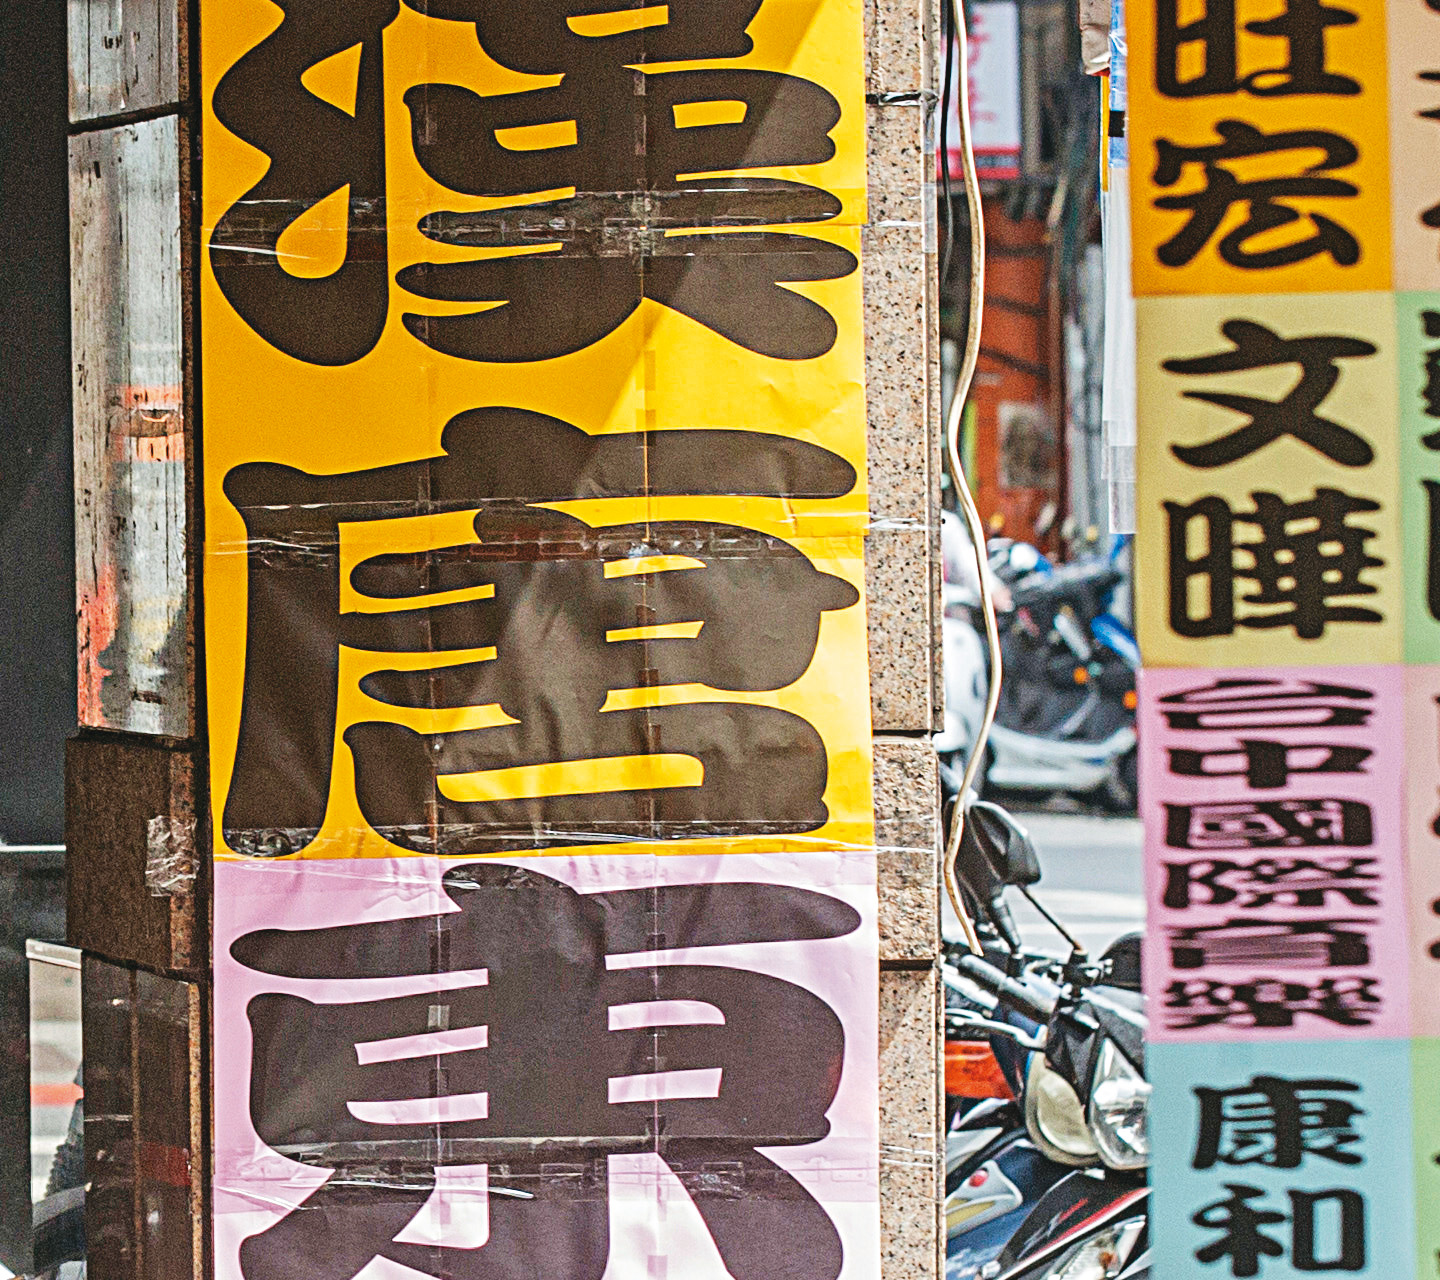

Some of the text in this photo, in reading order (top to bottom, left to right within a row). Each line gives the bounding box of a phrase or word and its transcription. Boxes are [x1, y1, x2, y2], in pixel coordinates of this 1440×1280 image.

[1159, 680, 1380, 1029] 台中國際育樂
